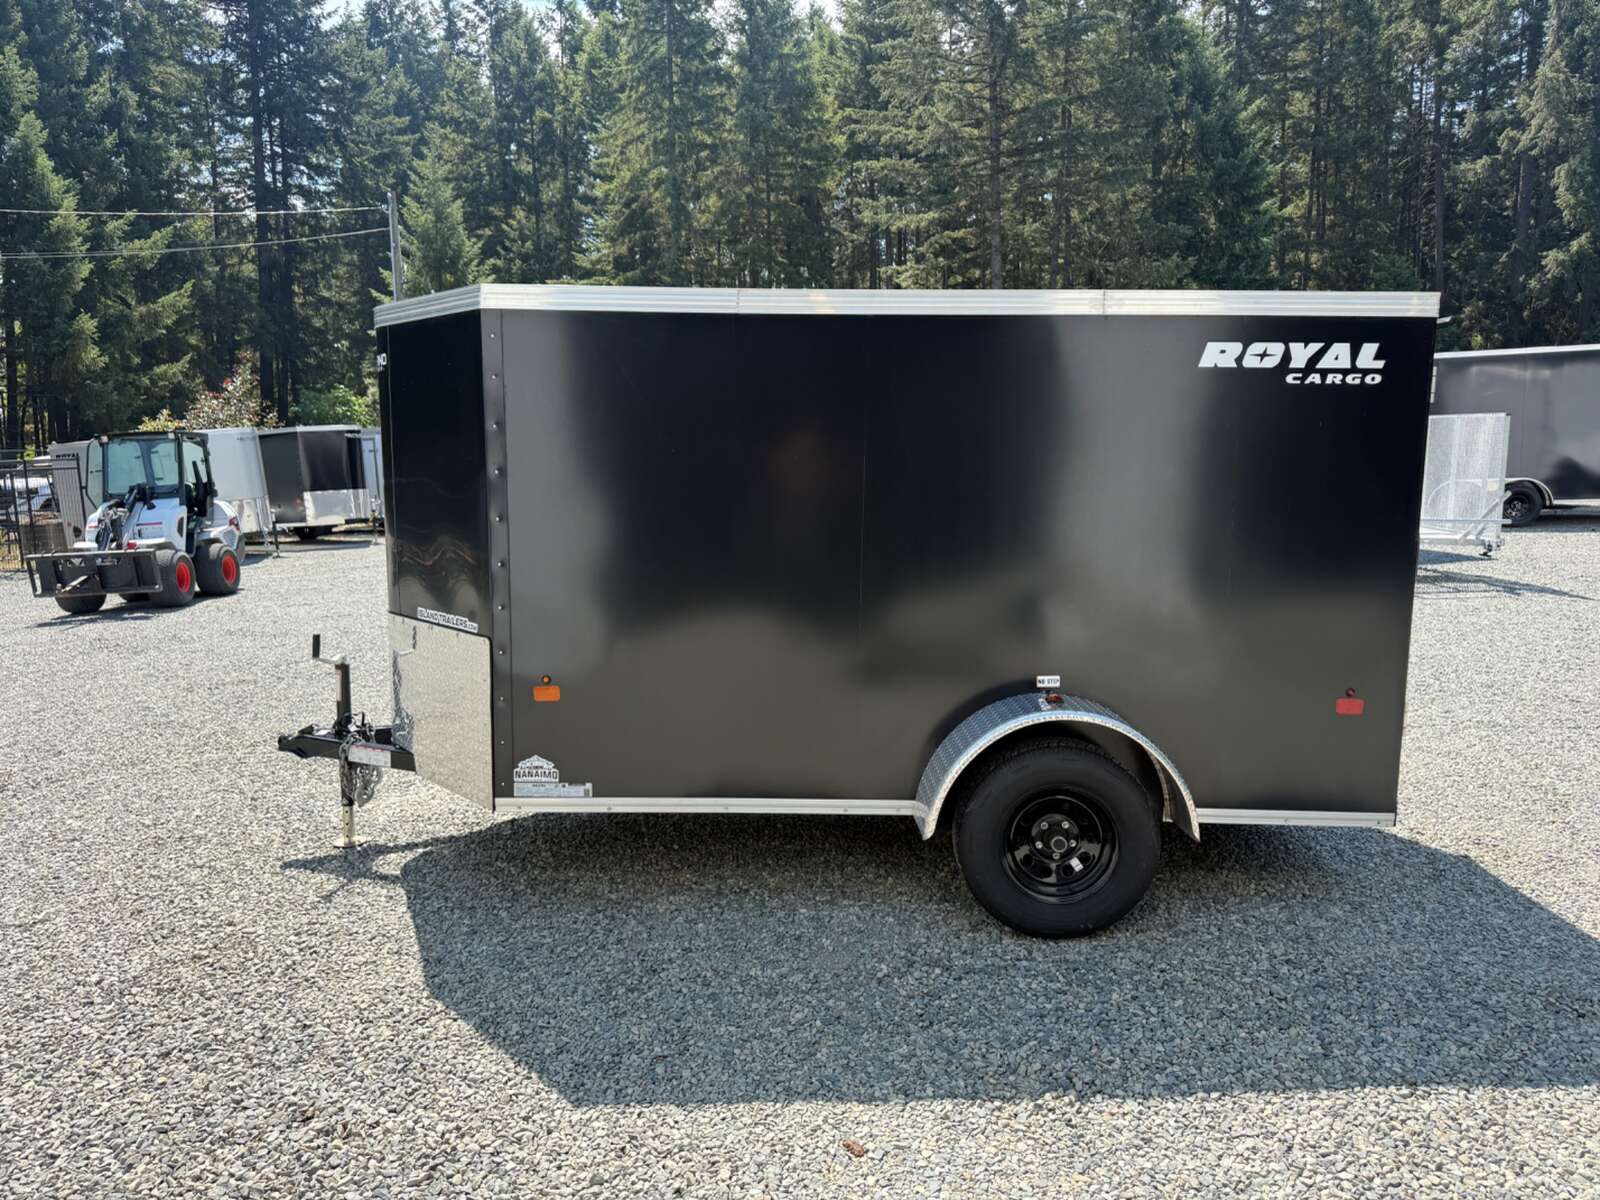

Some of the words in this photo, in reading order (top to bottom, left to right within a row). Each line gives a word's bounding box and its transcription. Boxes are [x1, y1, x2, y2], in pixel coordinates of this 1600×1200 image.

[1198, 341, 1386, 369] ROYAL
[1285, 373, 1383, 385] CARGO
[514, 769, 558, 780] NANAIMO
